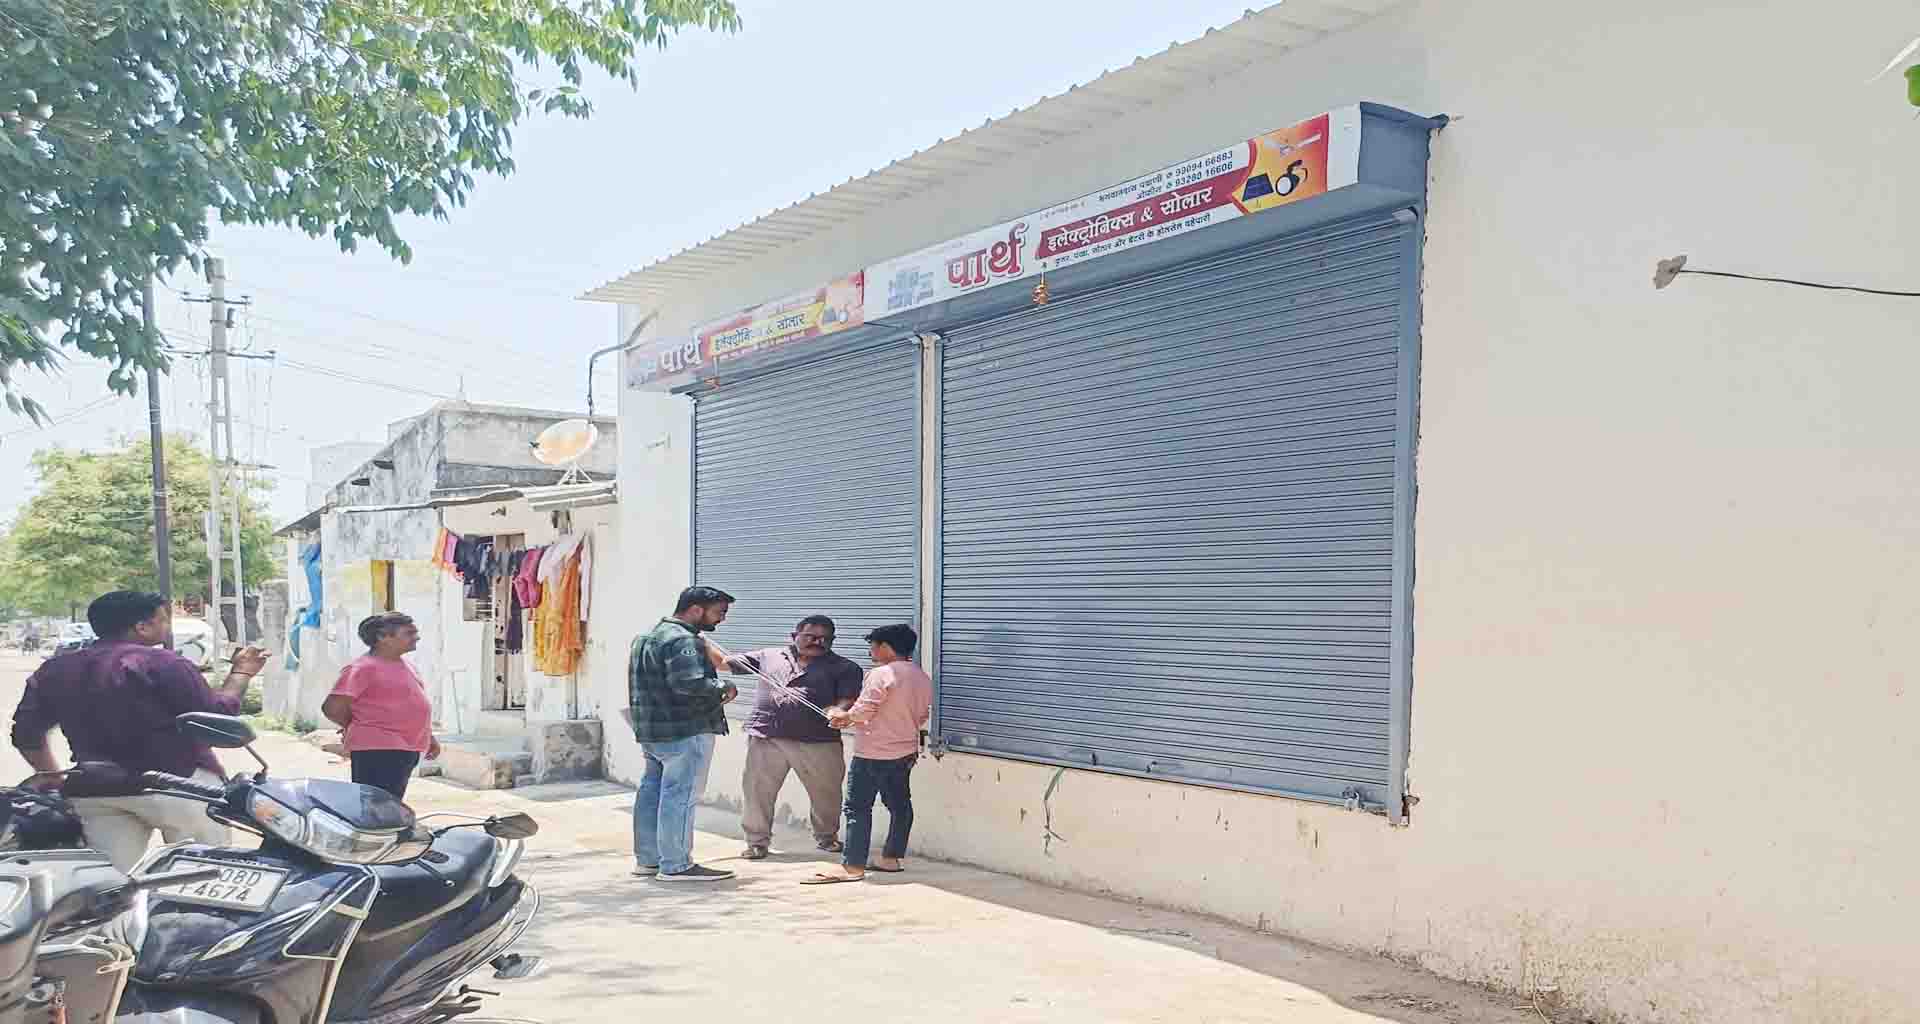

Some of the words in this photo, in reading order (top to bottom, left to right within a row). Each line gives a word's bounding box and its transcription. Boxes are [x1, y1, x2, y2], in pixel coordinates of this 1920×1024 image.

[1204, 151, 1233, 167] 66883
[1204, 162, 1233, 178] 16606
[1140, 206, 1153, 222] &
[1159, 186, 1213, 216] सोलार
[945, 222, 1029, 291] पार्थ
[660, 332, 703, 373] पार्थ
